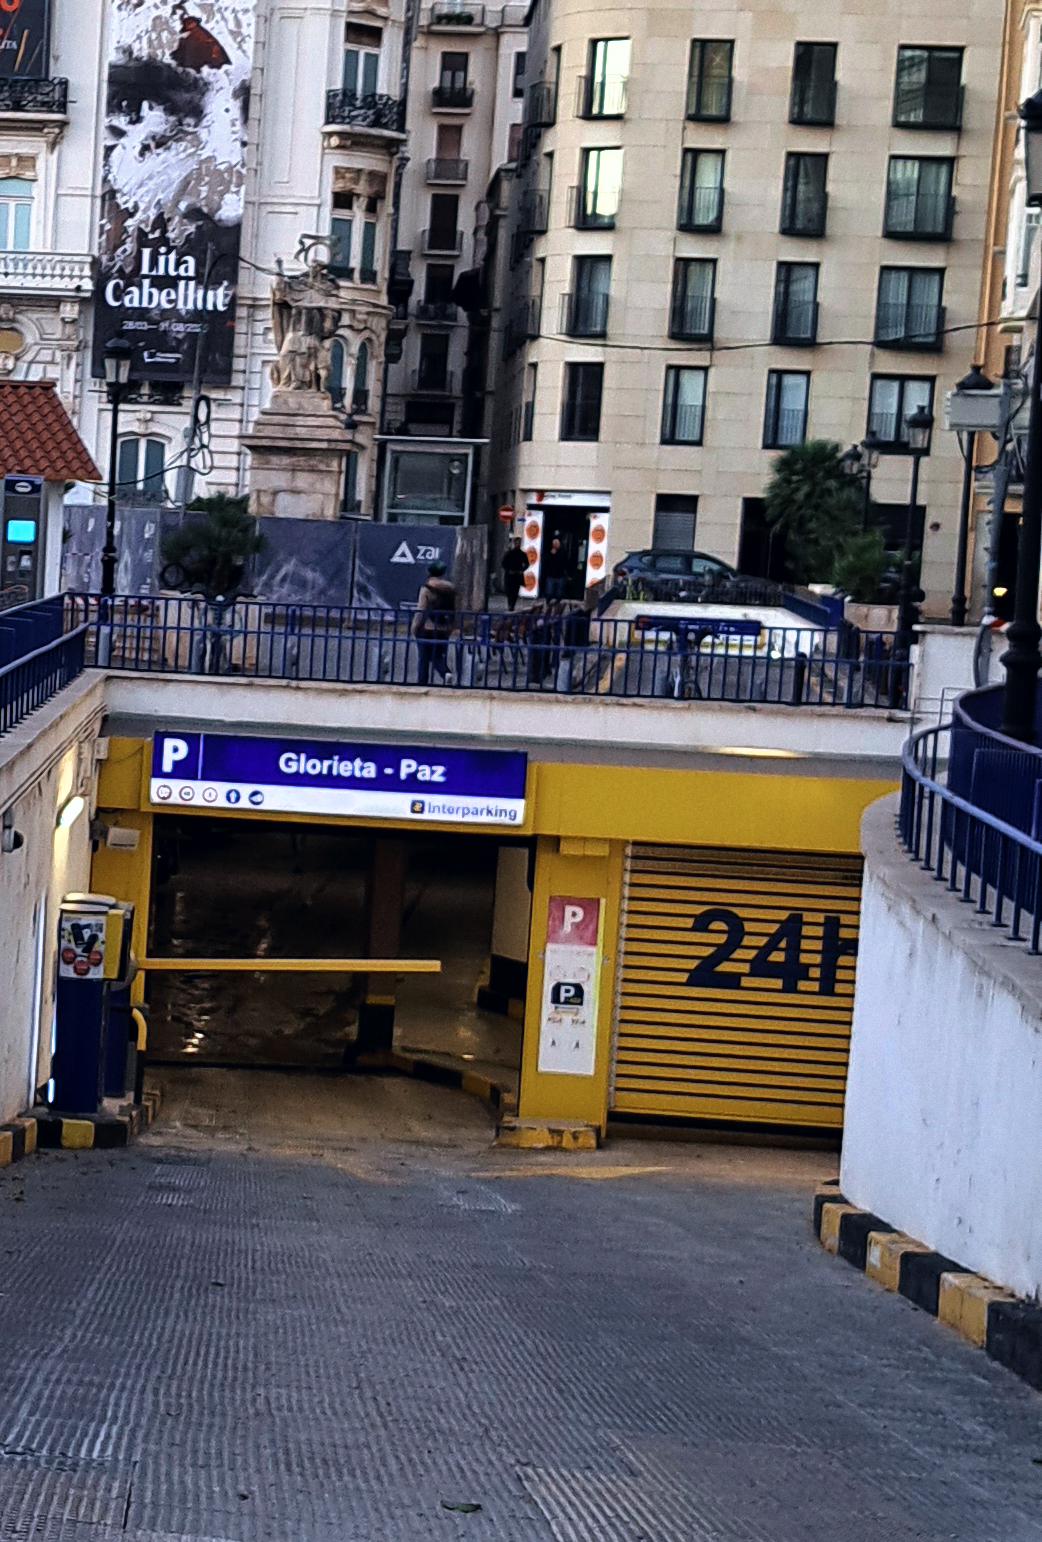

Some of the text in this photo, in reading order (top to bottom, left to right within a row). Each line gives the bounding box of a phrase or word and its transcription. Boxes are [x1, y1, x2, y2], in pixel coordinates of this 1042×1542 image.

[140, 246, 197, 277] Lita
[105, 278, 229, 312] Cabellut
[161, 737, 189, 773] P
[278, 752, 378, 779] Glorieta
[399, 758, 447, 783] Paz
[427, 802, 518, 821] Interparking
[563, 904, 585, 934] P
[559, 985, 576, 1003] P
